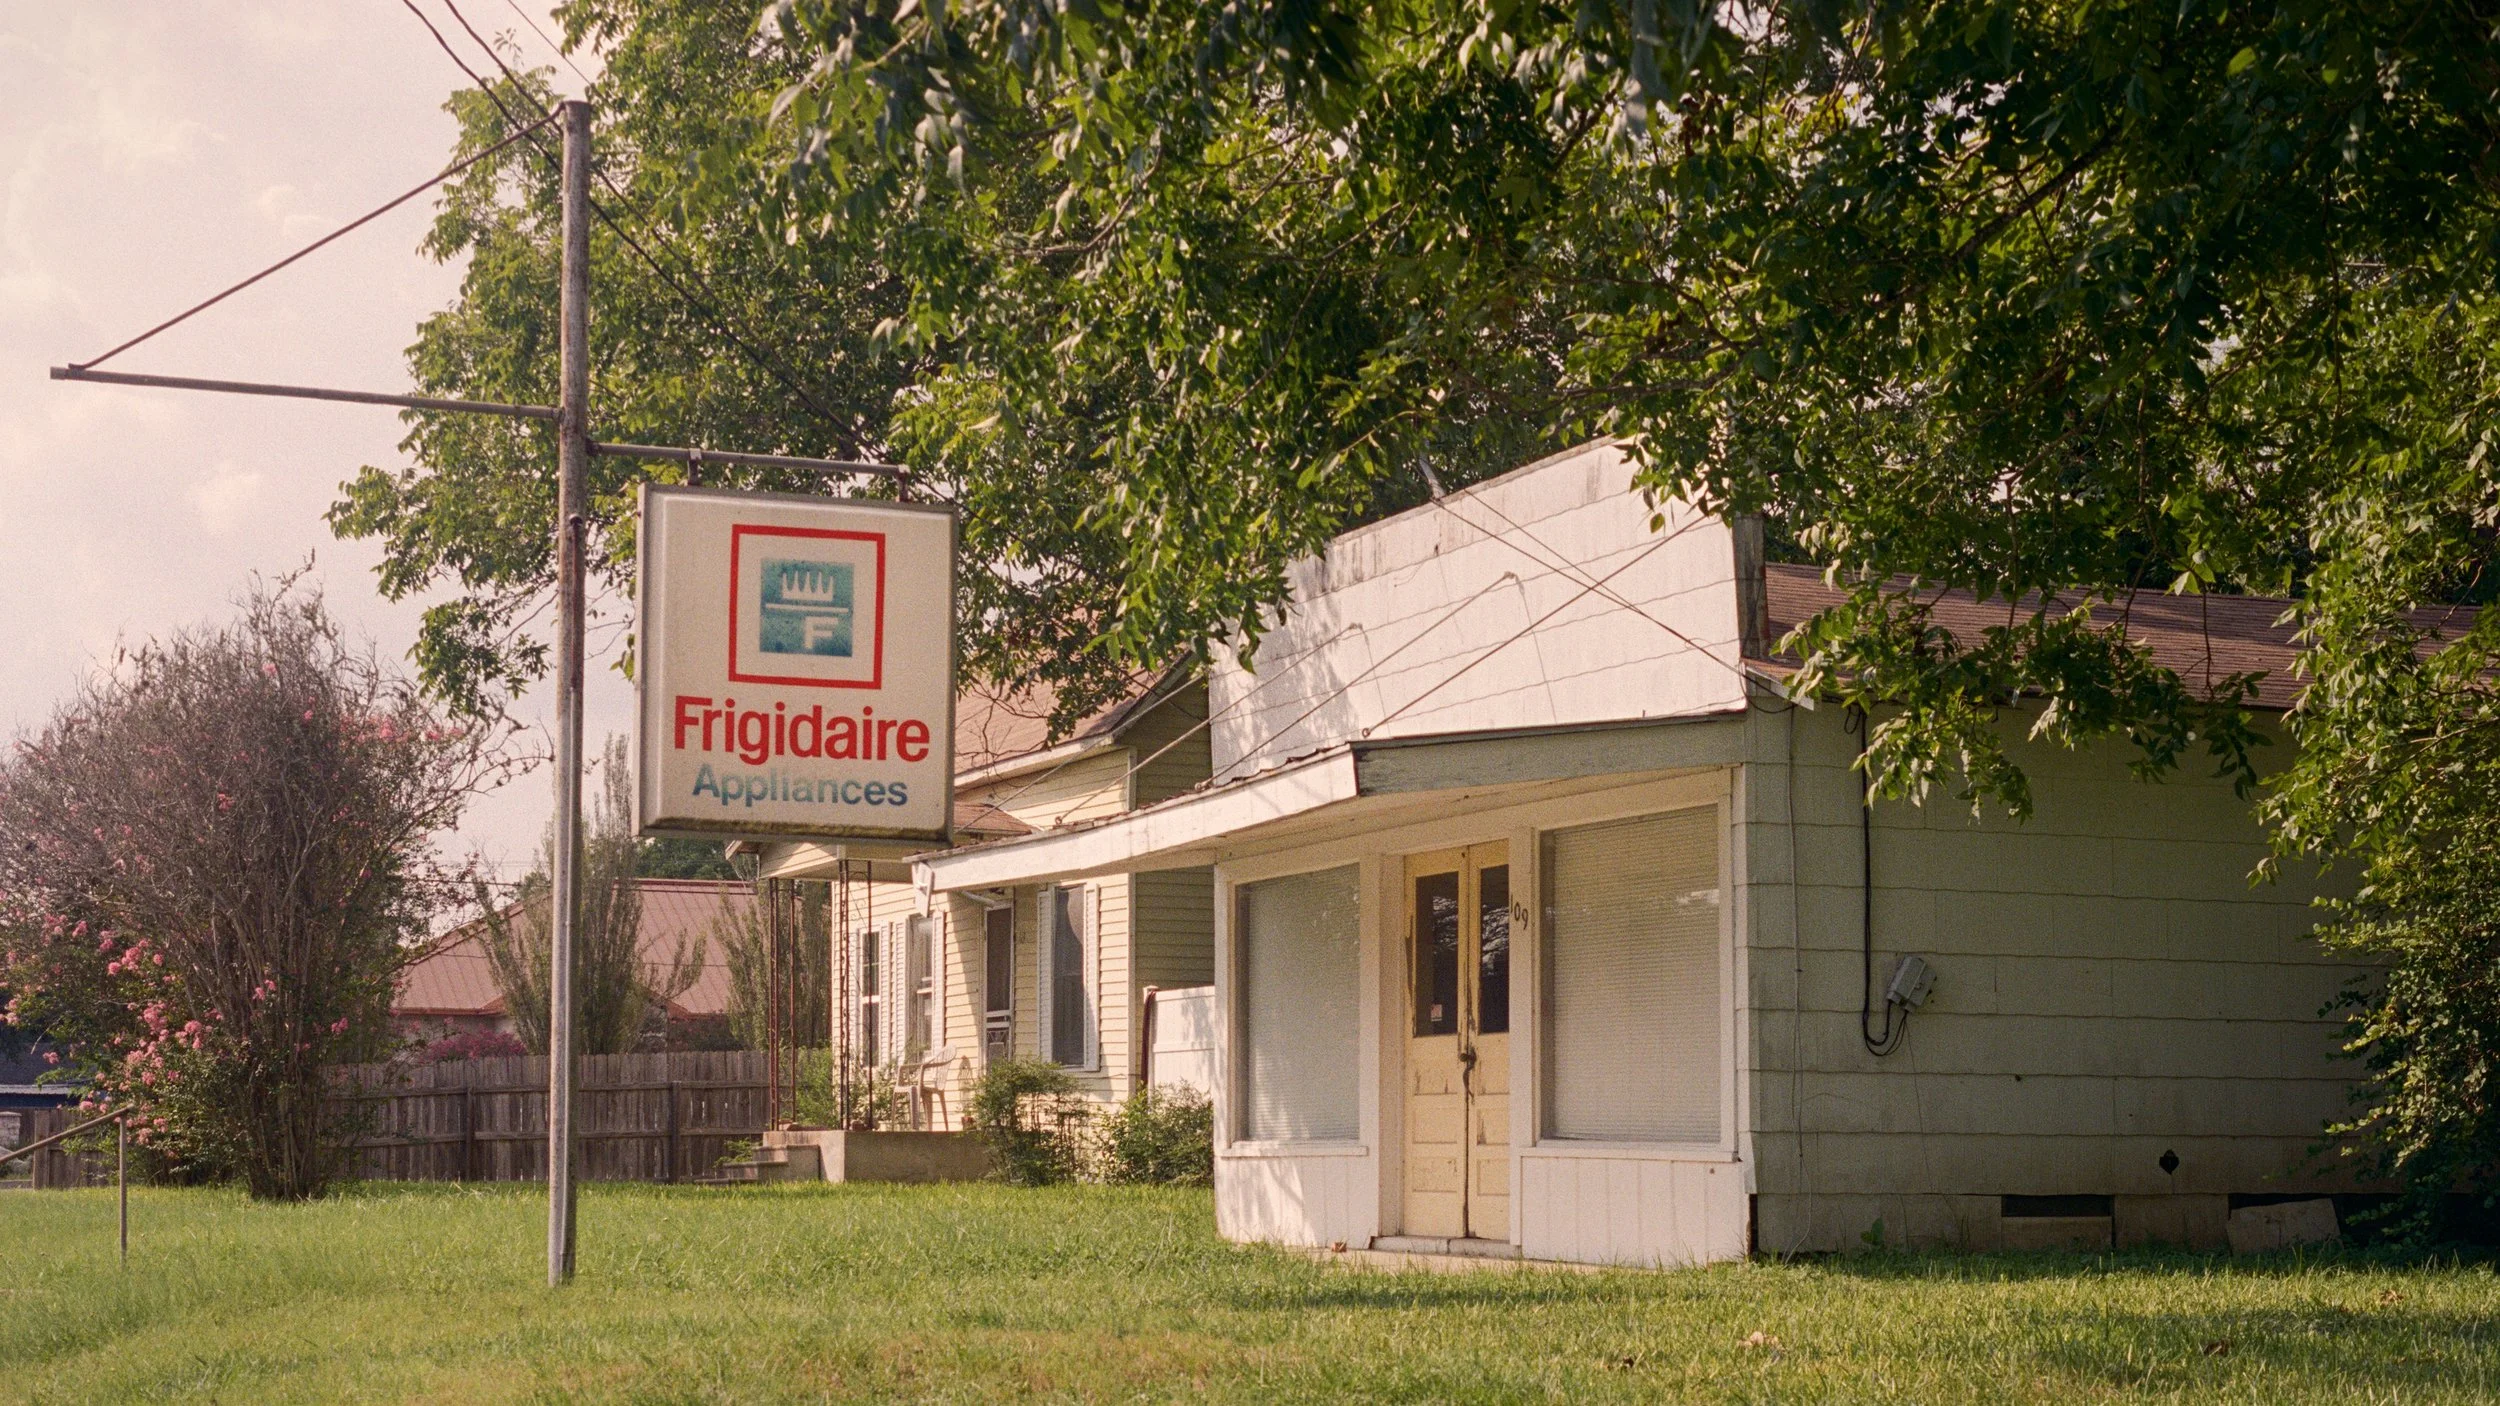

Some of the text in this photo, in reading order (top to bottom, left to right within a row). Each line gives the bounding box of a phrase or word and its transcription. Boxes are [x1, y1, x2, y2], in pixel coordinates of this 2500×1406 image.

[804, 615, 839, 650] F
[674, 695, 930, 765] Frigidaire
[692, 763, 908, 807] Appliances
[1510, 894, 1529, 930] 109
